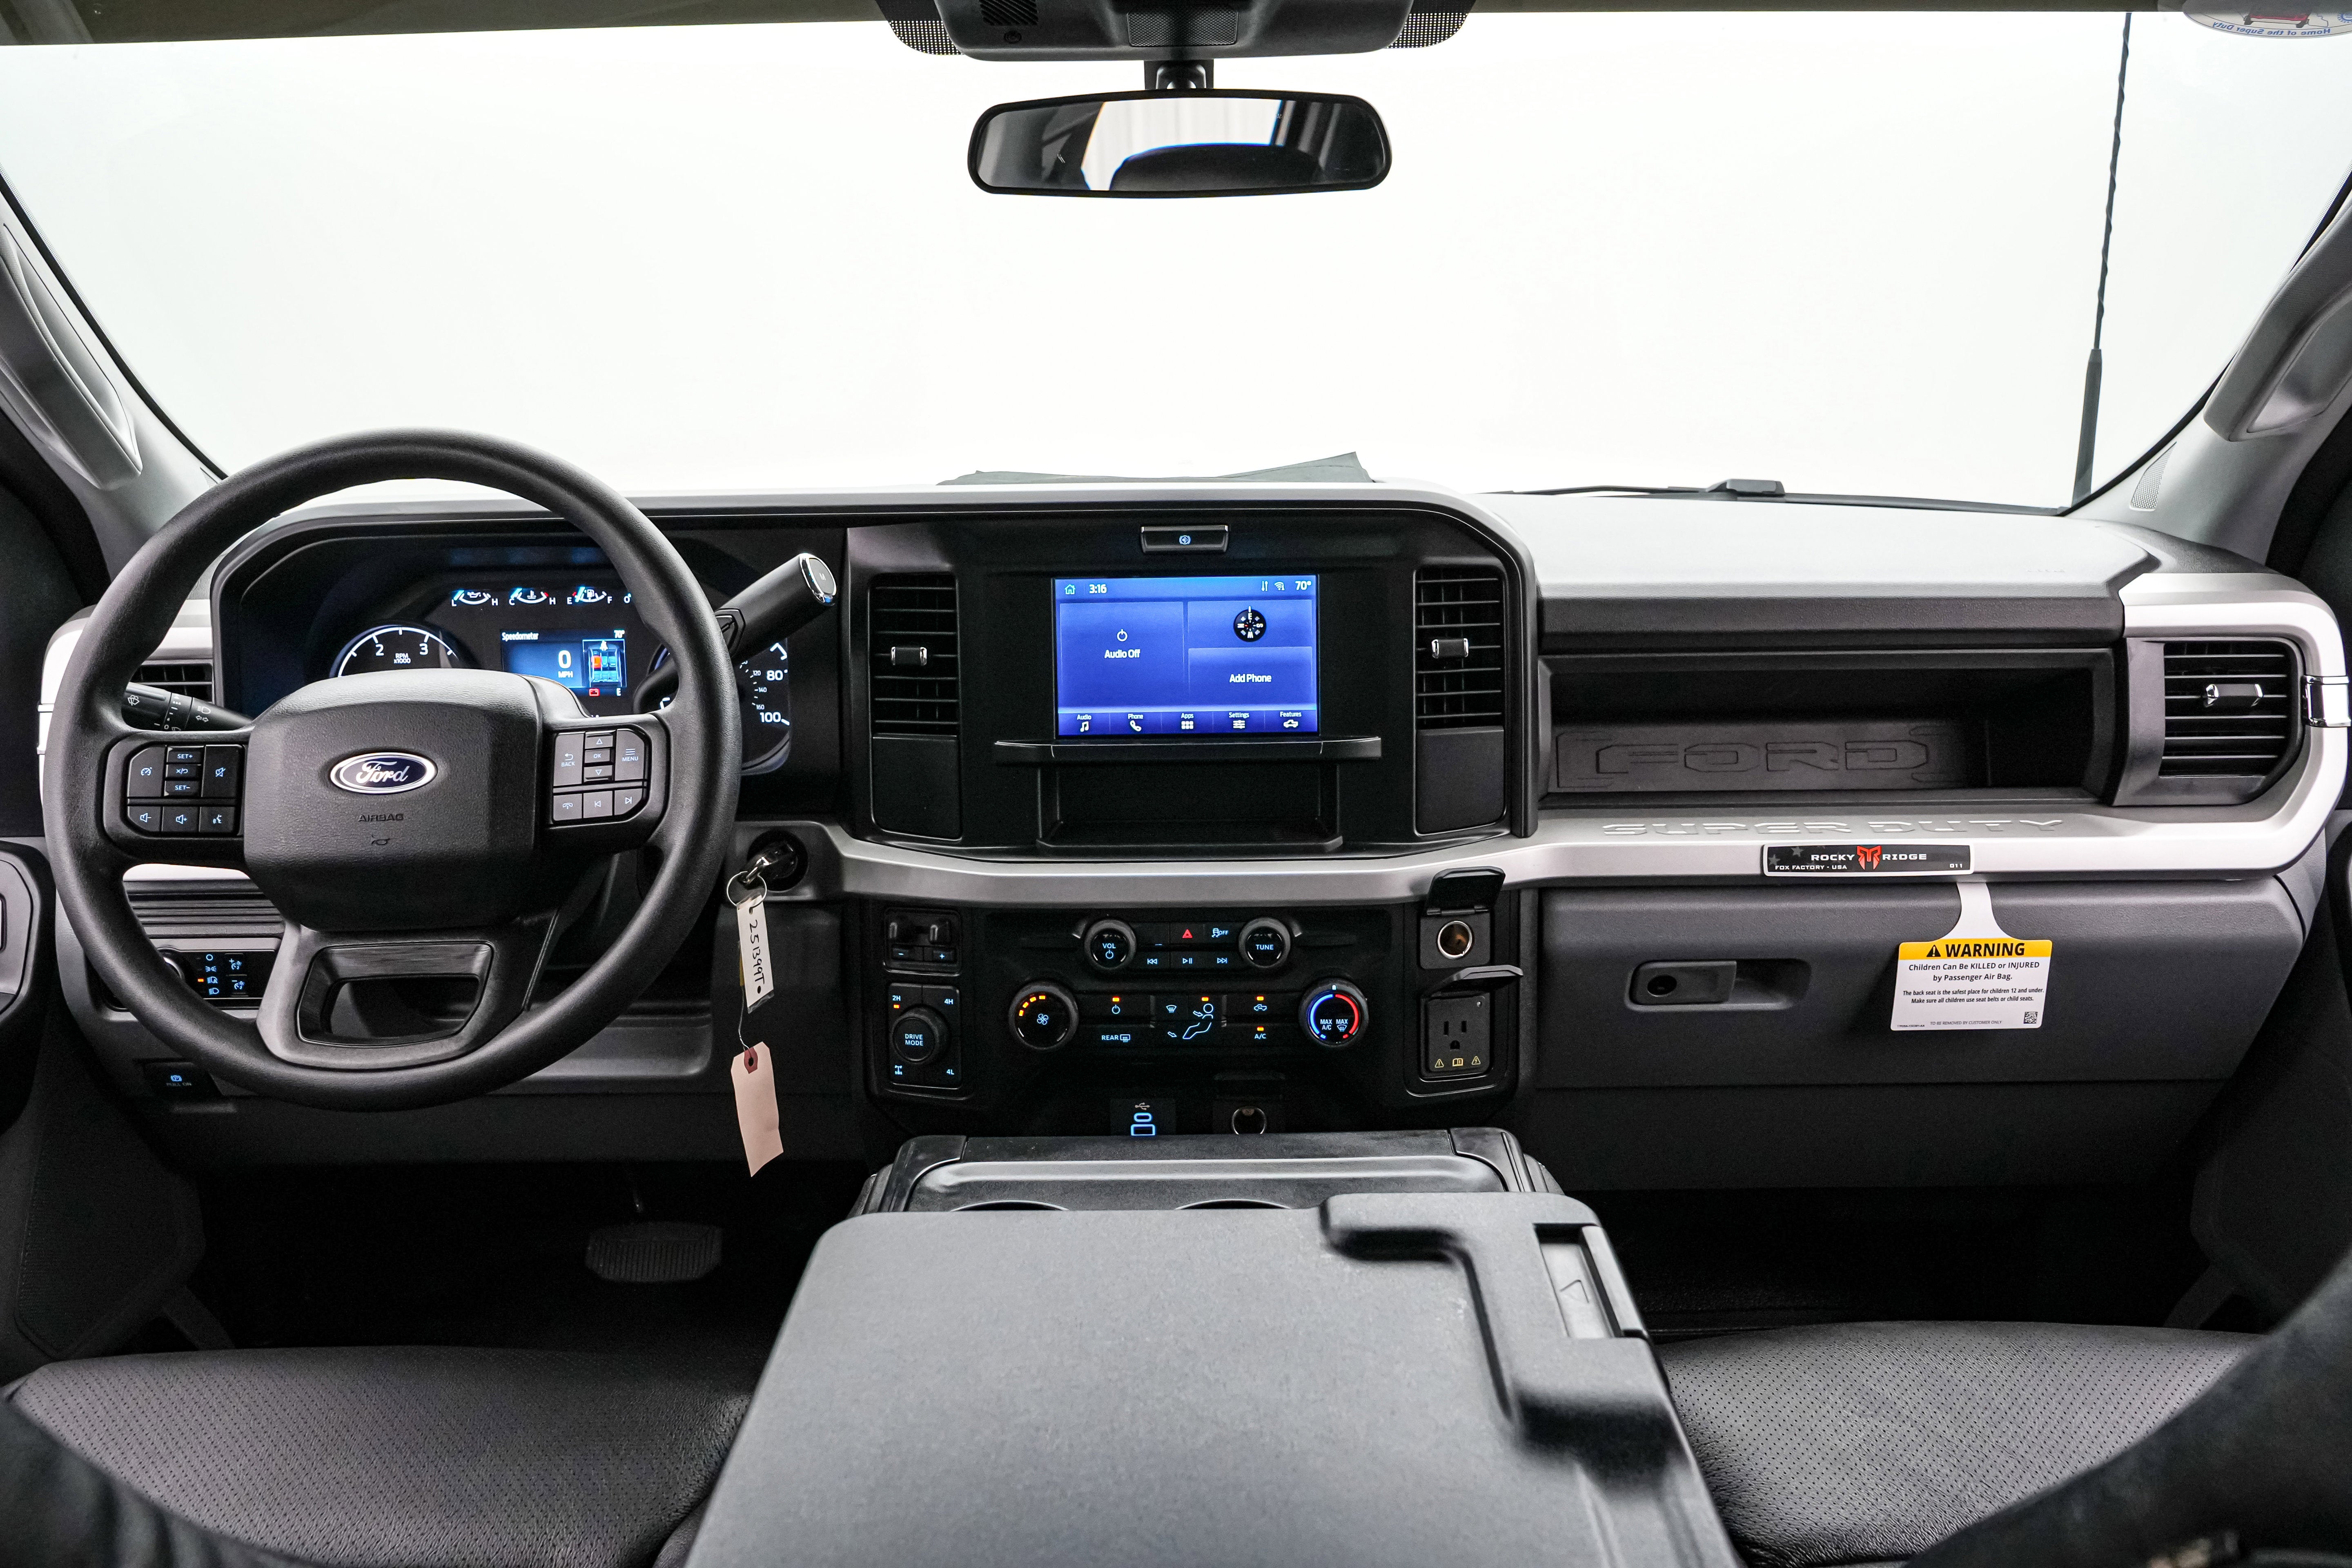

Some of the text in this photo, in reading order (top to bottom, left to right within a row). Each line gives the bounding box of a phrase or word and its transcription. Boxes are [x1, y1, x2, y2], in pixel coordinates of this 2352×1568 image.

[1089, 584, 1107, 594] 3:16
[1295, 581, 1312, 591] 70°
[502, 633, 539, 641] Speedometer
[375, 644, 384, 656] 2
[419, 643, 428, 655] 3
[1104, 649, 1140, 659] Audio Off
[558, 650, 571, 668] 0
[766, 670, 783, 681] 80
[1229, 674, 1272, 683] Add Phone
[616, 688, 621, 696] E
[760, 712, 781, 723] 100
[1596, 740, 1929, 775] FORD
[356, 760, 410, 784] Ford
[358, 813, 404, 822] AIRBAG
[1601, 820, 2063, 835] SUPER DUTY
[1945, 942, 2025, 957] WARNING
[1944, 974, 1982, 982] Passenger
[1997, 973, 2013, 981] Bag.
